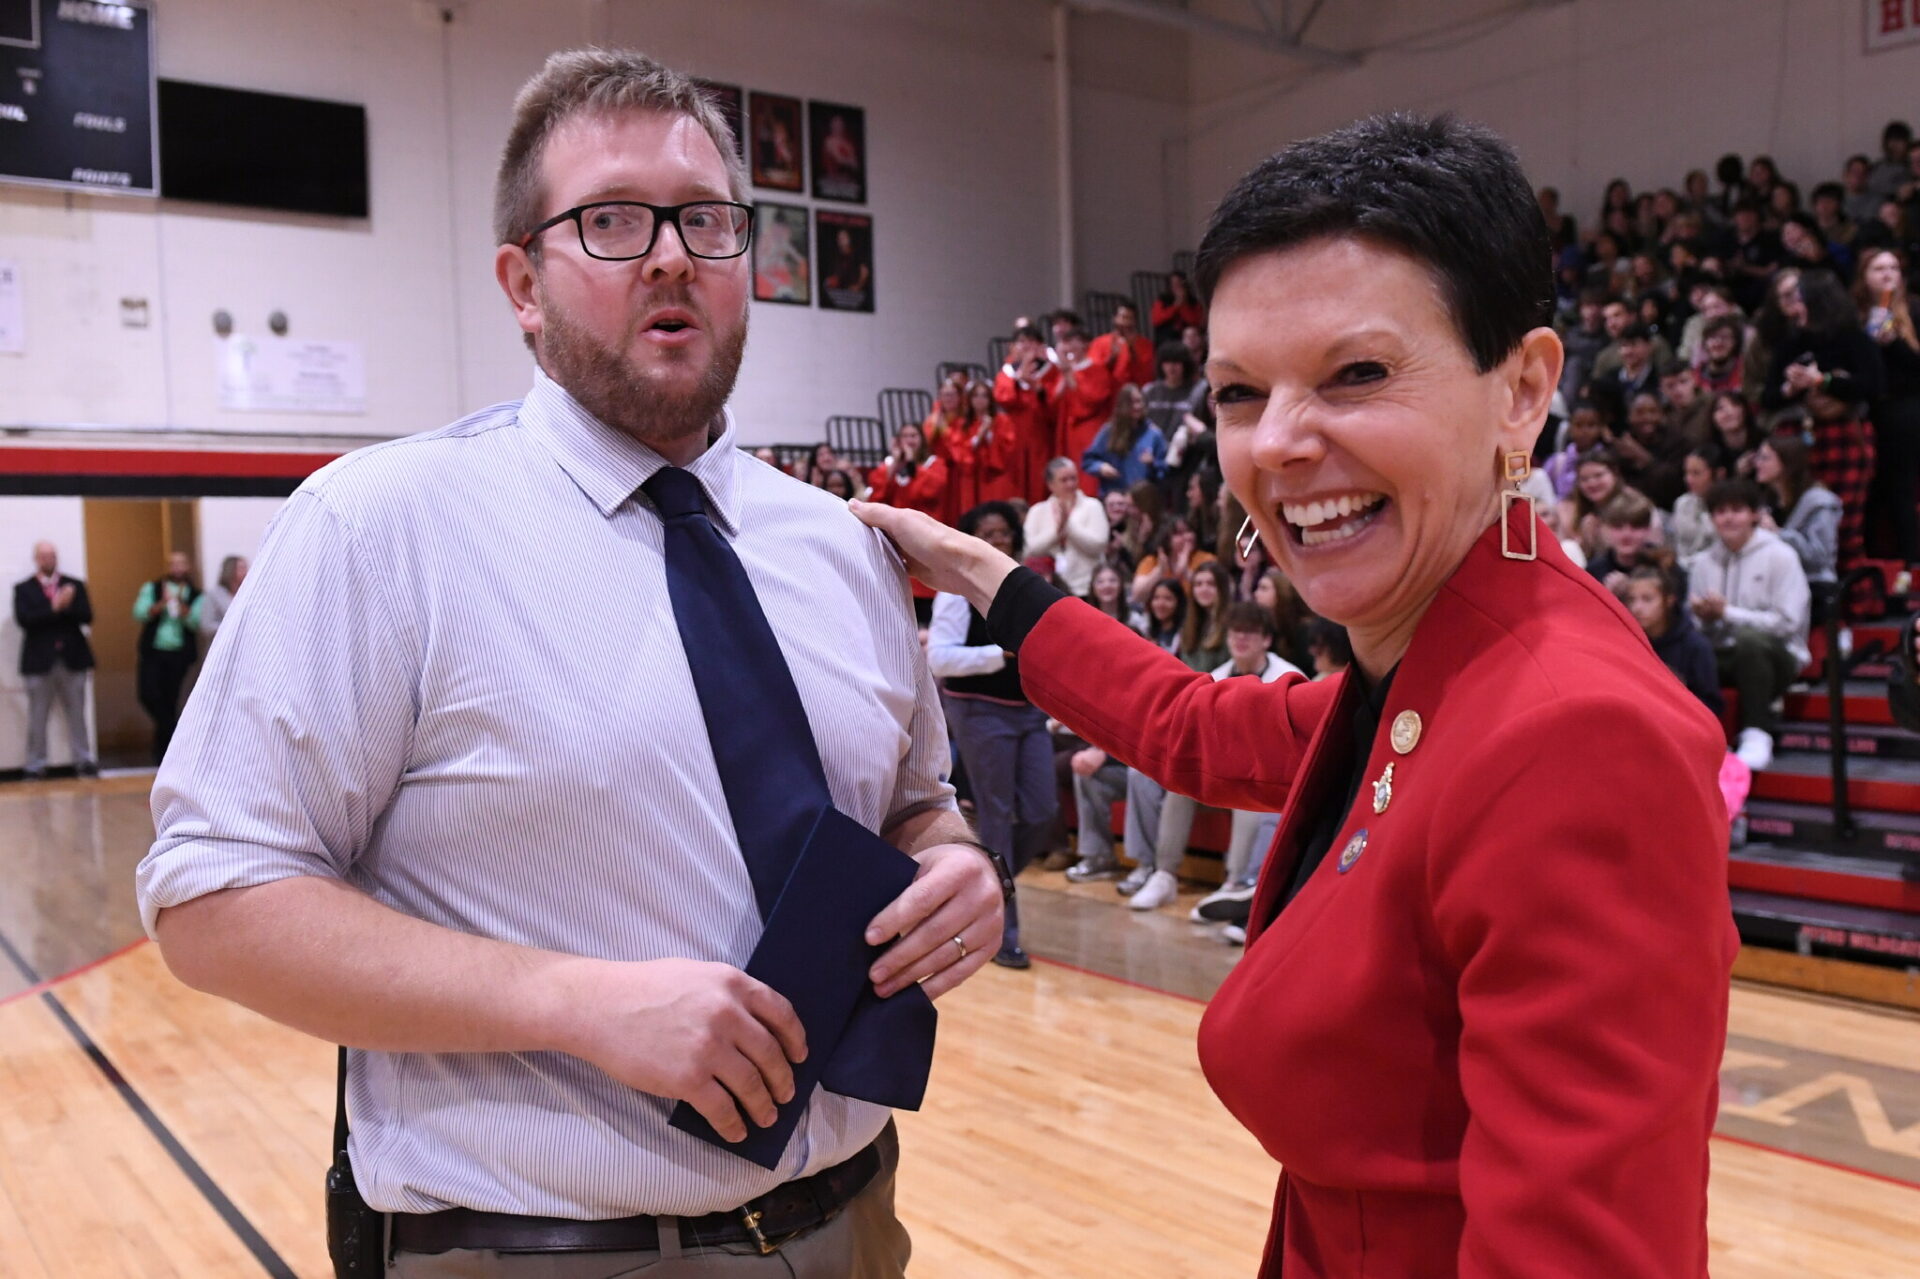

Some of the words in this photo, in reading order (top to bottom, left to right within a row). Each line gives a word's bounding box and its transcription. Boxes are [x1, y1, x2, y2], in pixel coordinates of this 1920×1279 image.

[58, 1, 136, 30] HOME
[73, 112, 126, 133] FOULS
[71, 167, 132, 187] POINTS
